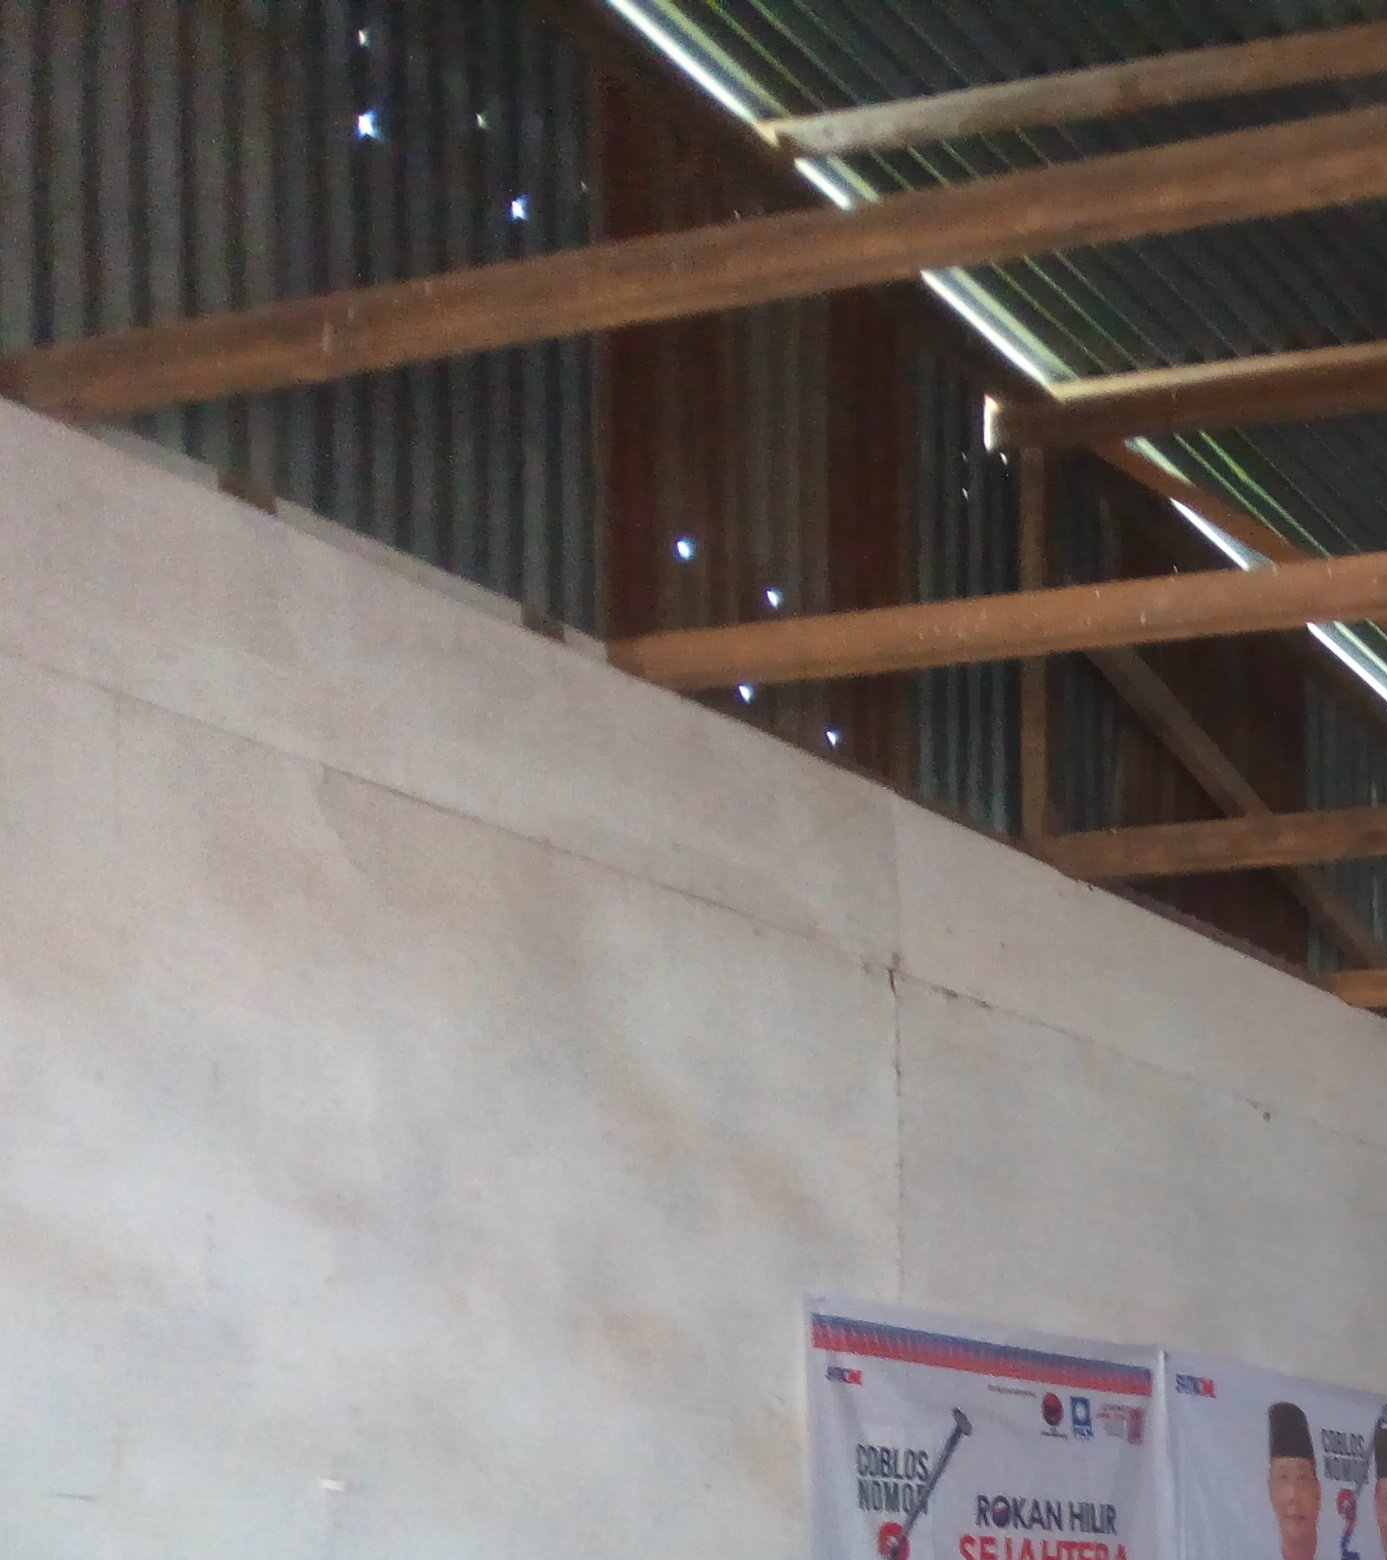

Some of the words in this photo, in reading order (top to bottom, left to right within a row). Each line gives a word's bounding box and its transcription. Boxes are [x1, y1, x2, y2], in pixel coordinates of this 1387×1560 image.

[857, 1443, 929, 1481] COBLOS
[975, 1495, 1064, 1531] ROKAN
[1068, 1500, 1118, 1535] HILIR
